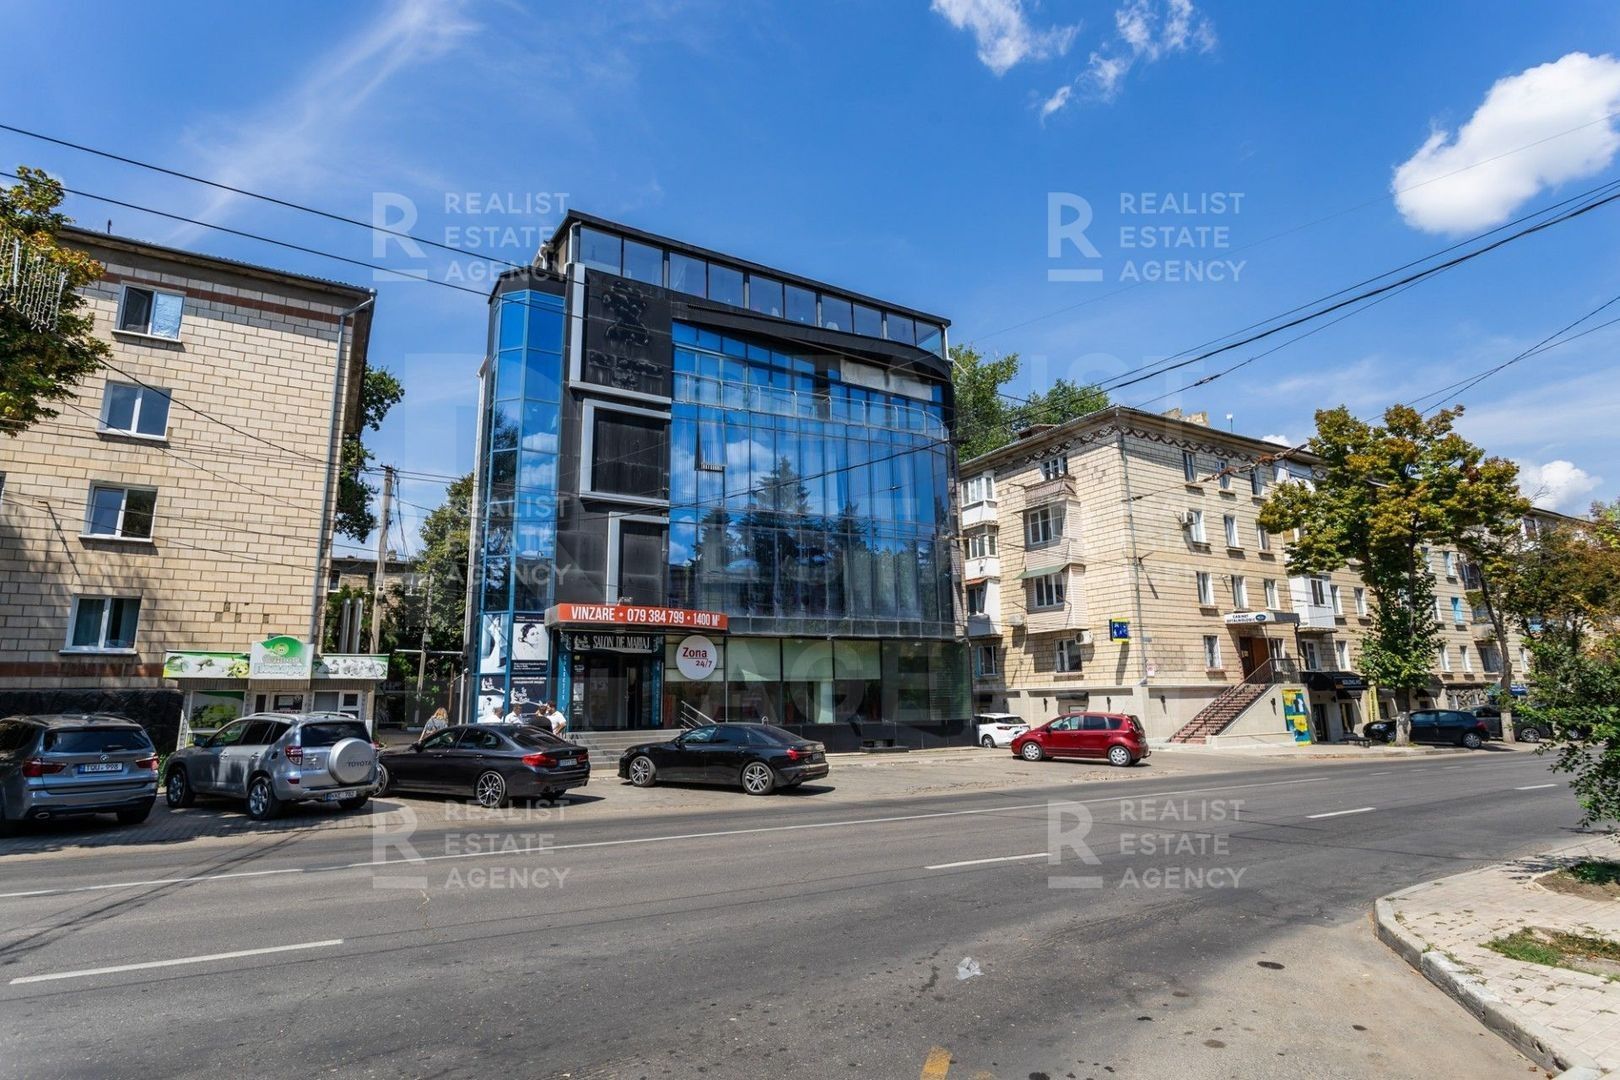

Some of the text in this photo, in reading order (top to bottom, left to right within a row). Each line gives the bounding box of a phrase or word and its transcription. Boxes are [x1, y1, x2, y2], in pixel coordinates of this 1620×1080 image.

[571, 606, 615, 621] VINZARE
[627, 609, 646, 622] 079
[648, 610, 666, 623] 384
[669, 611, 684, 624] 799
[693, 613, 710, 626] 1400
[592, 636, 614, 649] SALON
[616, 637, 625, 649] DE
[683, 647, 707, 657] Zona
[696, 659, 712, 668] 24/7
